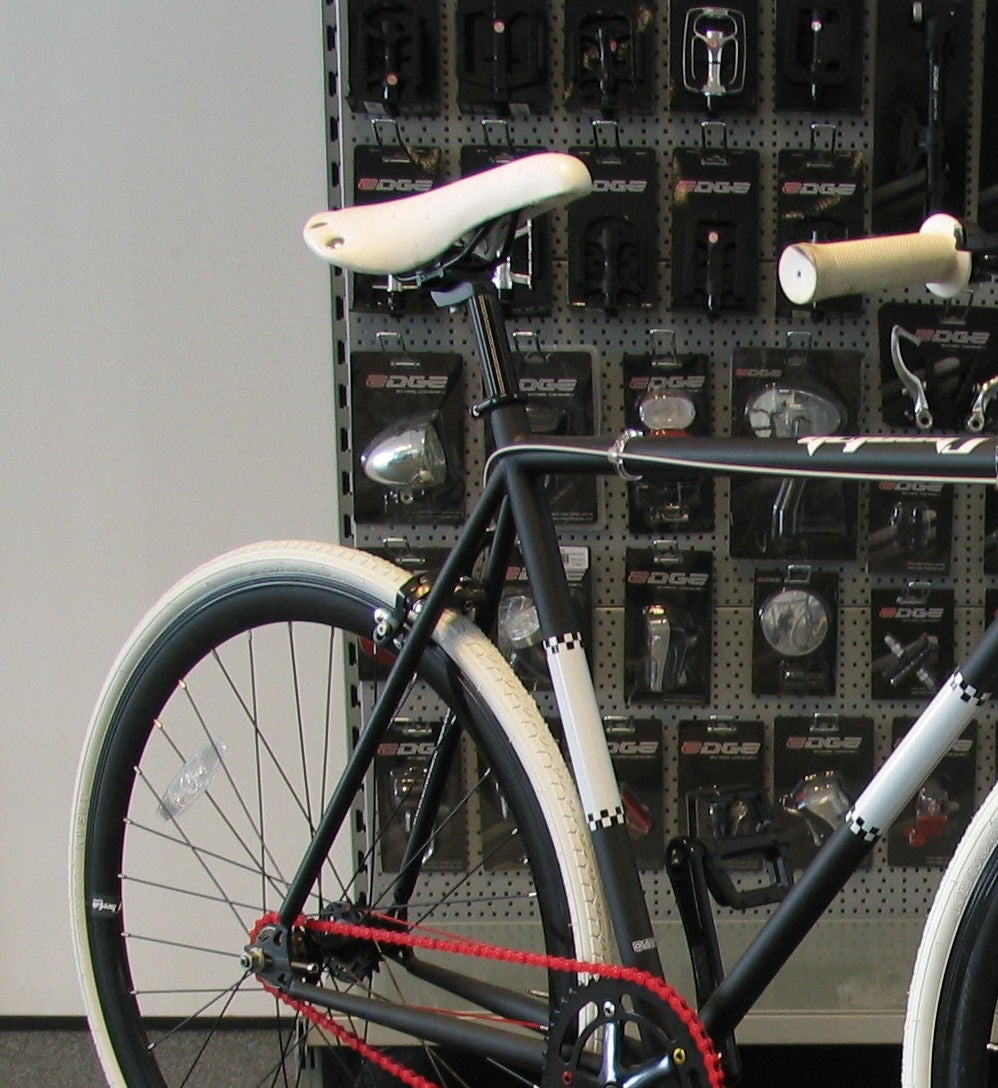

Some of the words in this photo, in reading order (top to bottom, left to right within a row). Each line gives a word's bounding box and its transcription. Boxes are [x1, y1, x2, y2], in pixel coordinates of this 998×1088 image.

[358, 178, 433, 191] EDGE
[592, 180, 648, 192] DGE
[675, 180, 751, 193] EDGE
[781, 182, 857, 195] EDGE
[366, 374, 448, 388] EDGE
[518, 378, 577, 392] DGE
[629, 376, 706, 389] EDGE
[628, 571, 709, 585] EDGE
[377, 742, 437, 756] EDG
[681, 742, 761, 755] EDGE
[786, 737, 862, 749] EDGE
